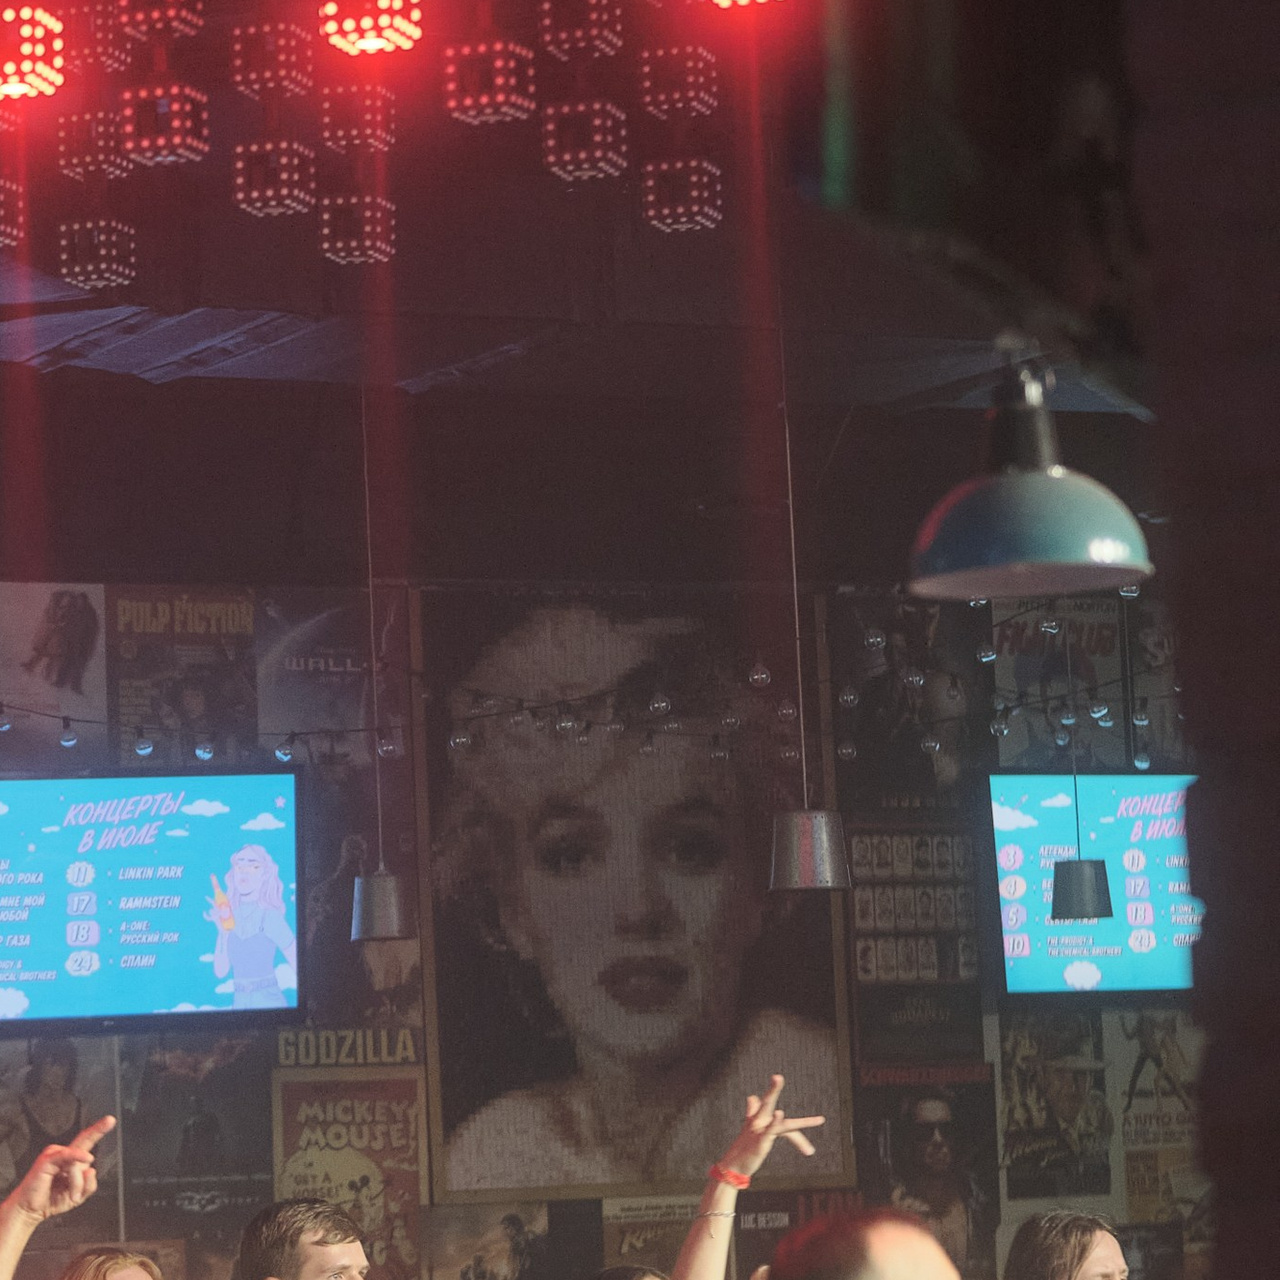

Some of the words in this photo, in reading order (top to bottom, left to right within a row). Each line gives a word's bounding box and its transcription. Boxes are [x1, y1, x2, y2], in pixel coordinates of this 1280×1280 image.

[117, 599, 170, 633] PULP
[174, 599, 254, 634] FICTION
[62, 790, 186, 827] КОНЦЕРТЫ
[1116, 790, 1187, 819] КОНЦЕР
[77, 829, 96, 853] В
[96, 821, 164, 851] ИЮЛЕ
[1130, 820, 1144, 843] В
[1145, 818, 1188, 841] ИЮЛ
[1006, 849, 1017, 867] 3
[17, 872, 44, 885] РОКА
[118, 867, 153, 880] LINKIN
[156, 866, 184, 879] PARK
[0, 896, 21, 908] МНЕ
[23, 892, 47, 907] МОЙ
[72, 895, 91, 914] 17
[119, 896, 182, 910] RAMMSTEIN
[5, 934, 32, 948] ГАЗА
[72, 927, 90, 943] 18
[120, 931, 160, 945] РУССКИЙ
[162, 932, 180, 944] РОК
[1008, 937, 1024, 954] 10
[73, 954, 93, 971] 24
[120, 954, 157, 968] СПЛИН
[19, 970, 58, 982] BROTHERS
[277, 1028, 417, 1066] GODZILLA
[296, 1099, 410, 1124] MICKEY
[740, 1213, 756, 1229] LUC
[758, 1212, 790, 1229] BESSON
